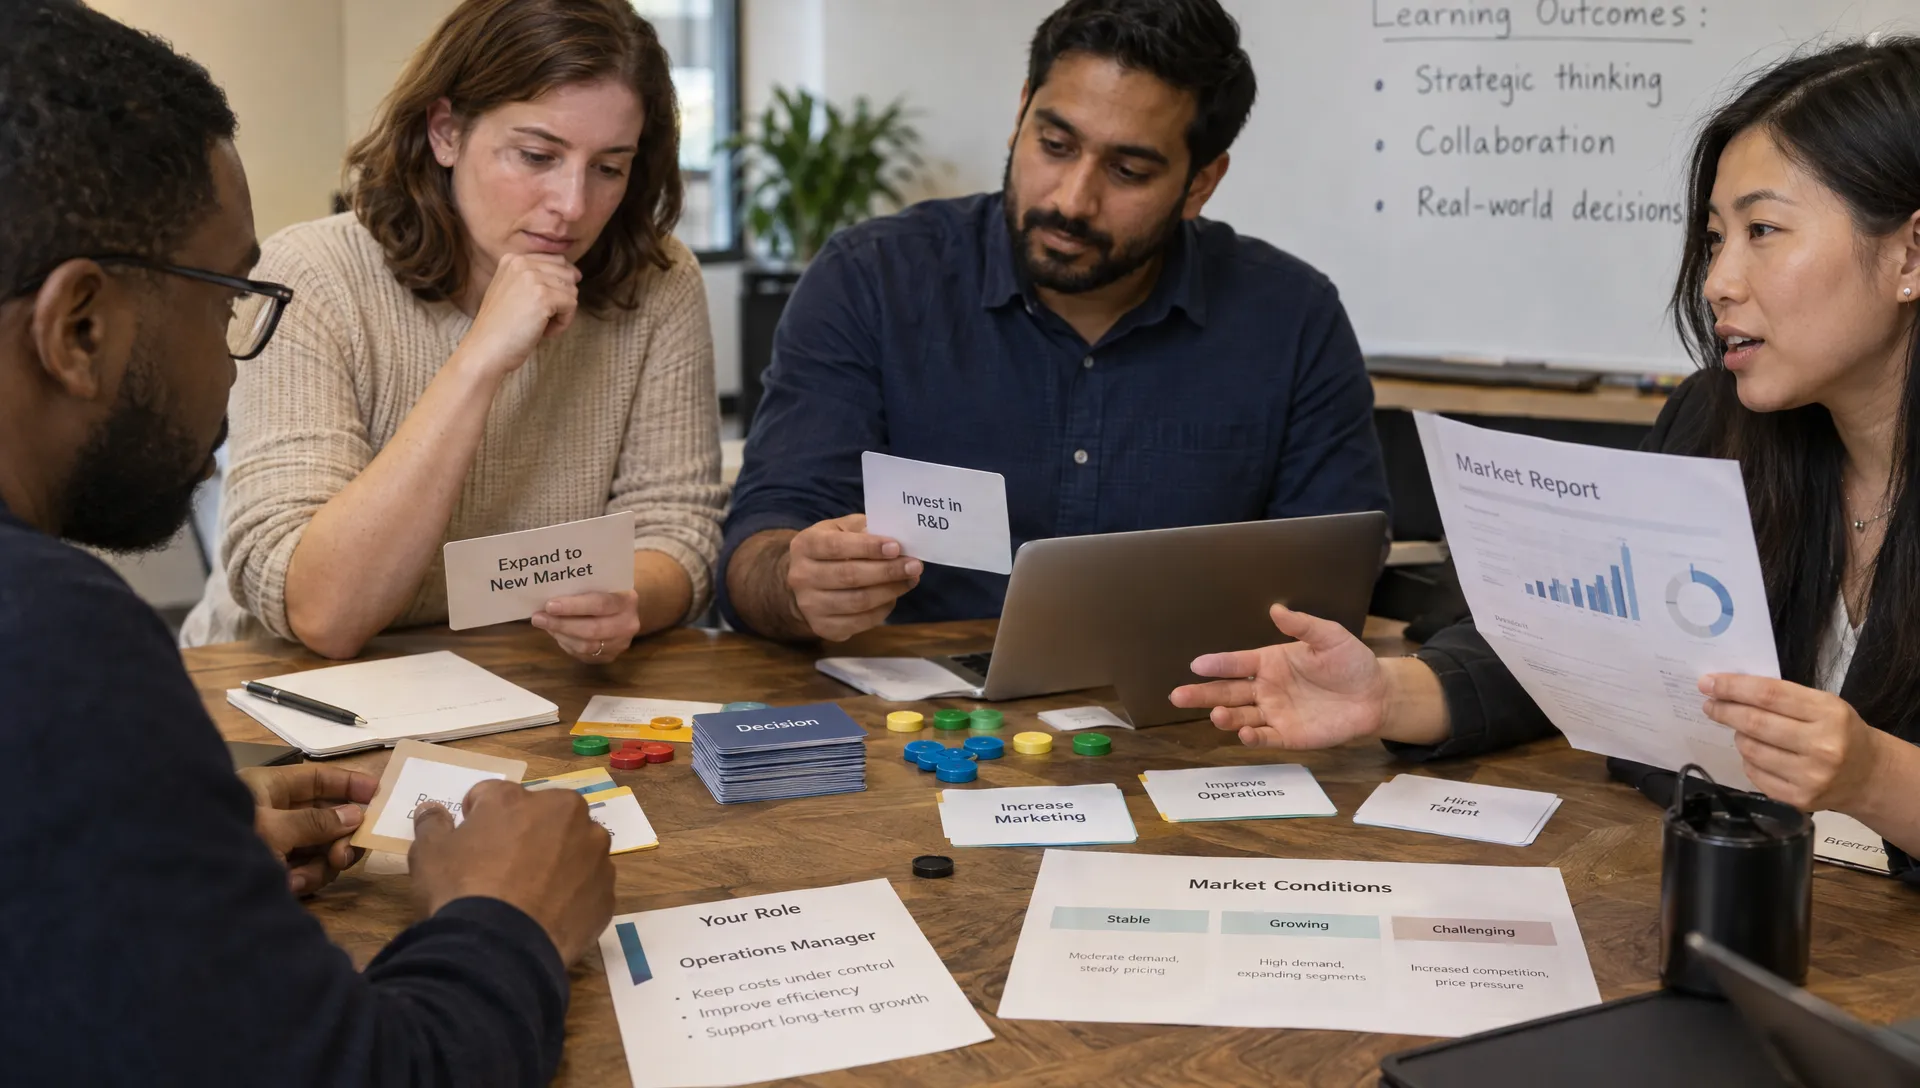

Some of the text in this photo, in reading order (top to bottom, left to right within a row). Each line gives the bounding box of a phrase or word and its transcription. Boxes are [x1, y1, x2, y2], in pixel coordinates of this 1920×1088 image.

[1373, 0, 1511, 39] Learning
[1416, 62, 1662, 108] Strategic thinking
[1417, 125, 1614, 155] Collaboration
[1418, 186, 1683, 224] Real-world decisions
[1456, 453, 1600, 500] Market Report
[903, 491, 962, 512] Invest in
[918, 514, 949, 530] R&D
[498, 549, 582, 571] Expand to
[491, 563, 593, 591] New Market
[735, 719, 820, 733] Decision
[1205, 779, 1266, 790] Improve
[1197, 788, 1285, 801] Operations
[1444, 796, 1477, 806] Hire
[1001, 801, 1074, 812] Increase
[1430, 804, 1480, 817] Talent
[995, 812, 1086, 825] Marketing
[1189, 878, 1393, 894] Market Conditions
[699, 904, 801, 927] Your Role
[1107, 914, 1151, 924] Stable
[1269, 919, 1329, 932] Growing
[1432, 924, 1516, 938] Challenging
[680, 932, 875, 968] Operations Manager
[1068, 951, 1179, 964] Moderate demand,
[1080, 965, 1166, 976] steady pricing
[1259, 958, 1345, 969] High demand,
[1410, 963, 1549, 979] Increased competition,
[691, 958, 895, 1001] Keep costs under control
[1237, 970, 1367, 982] expanding segments
[1435, 978, 1524, 990] price pressure
[699, 985, 860, 1019] Improve efficiency
[706, 994, 929, 1038] Support long-term growth
